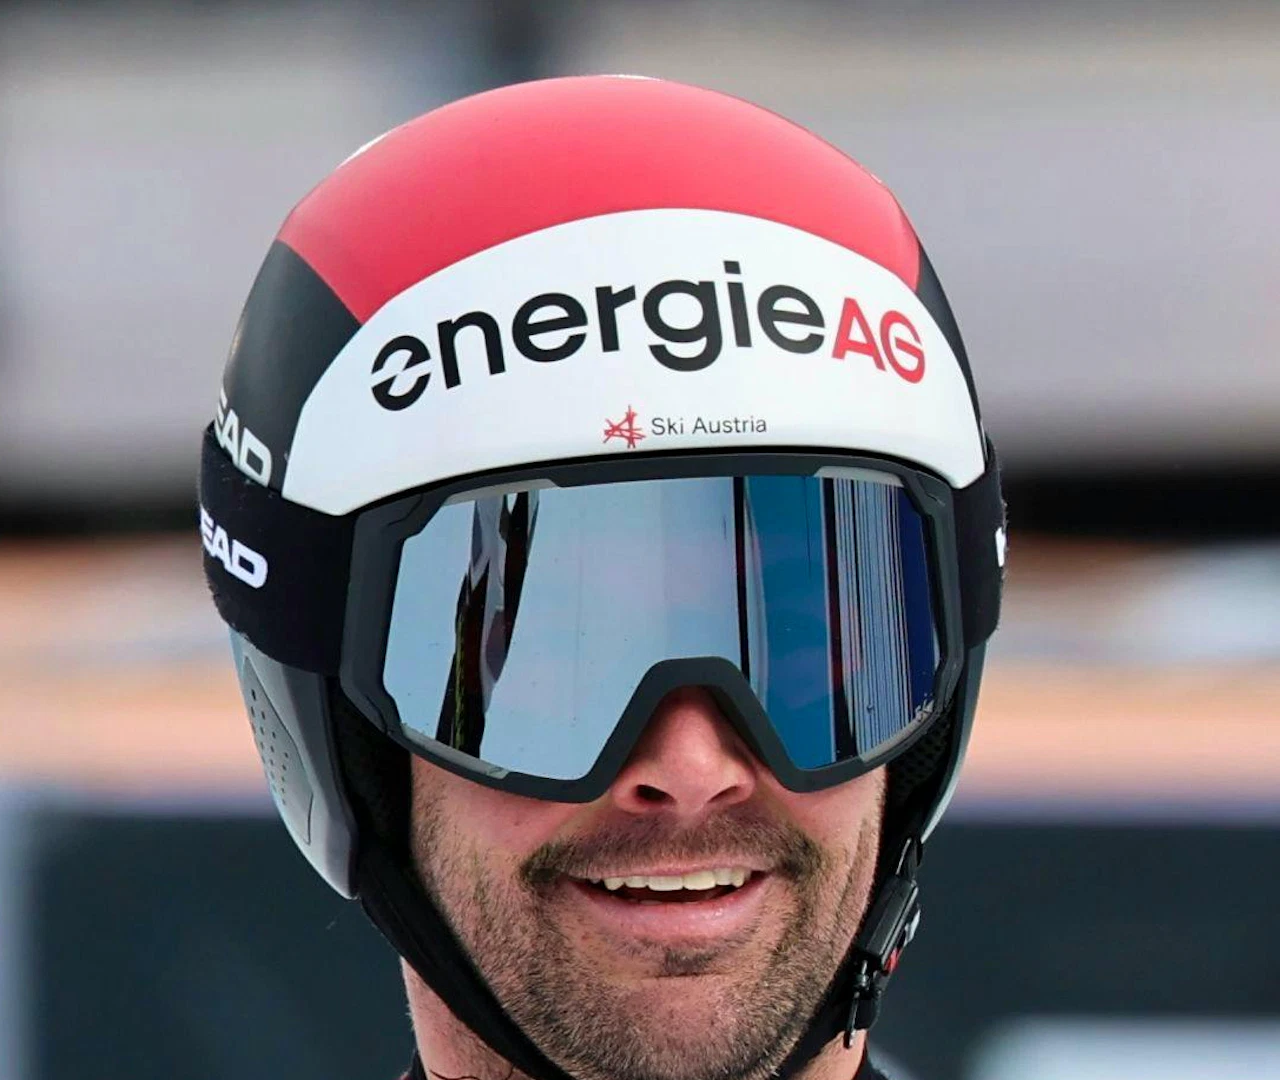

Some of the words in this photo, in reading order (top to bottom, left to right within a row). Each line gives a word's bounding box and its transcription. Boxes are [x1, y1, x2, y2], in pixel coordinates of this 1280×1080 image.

[651, 417, 684, 437] Ski
[692, 414, 768, 435] Austria
[200, 503, 269, 589] EAD
